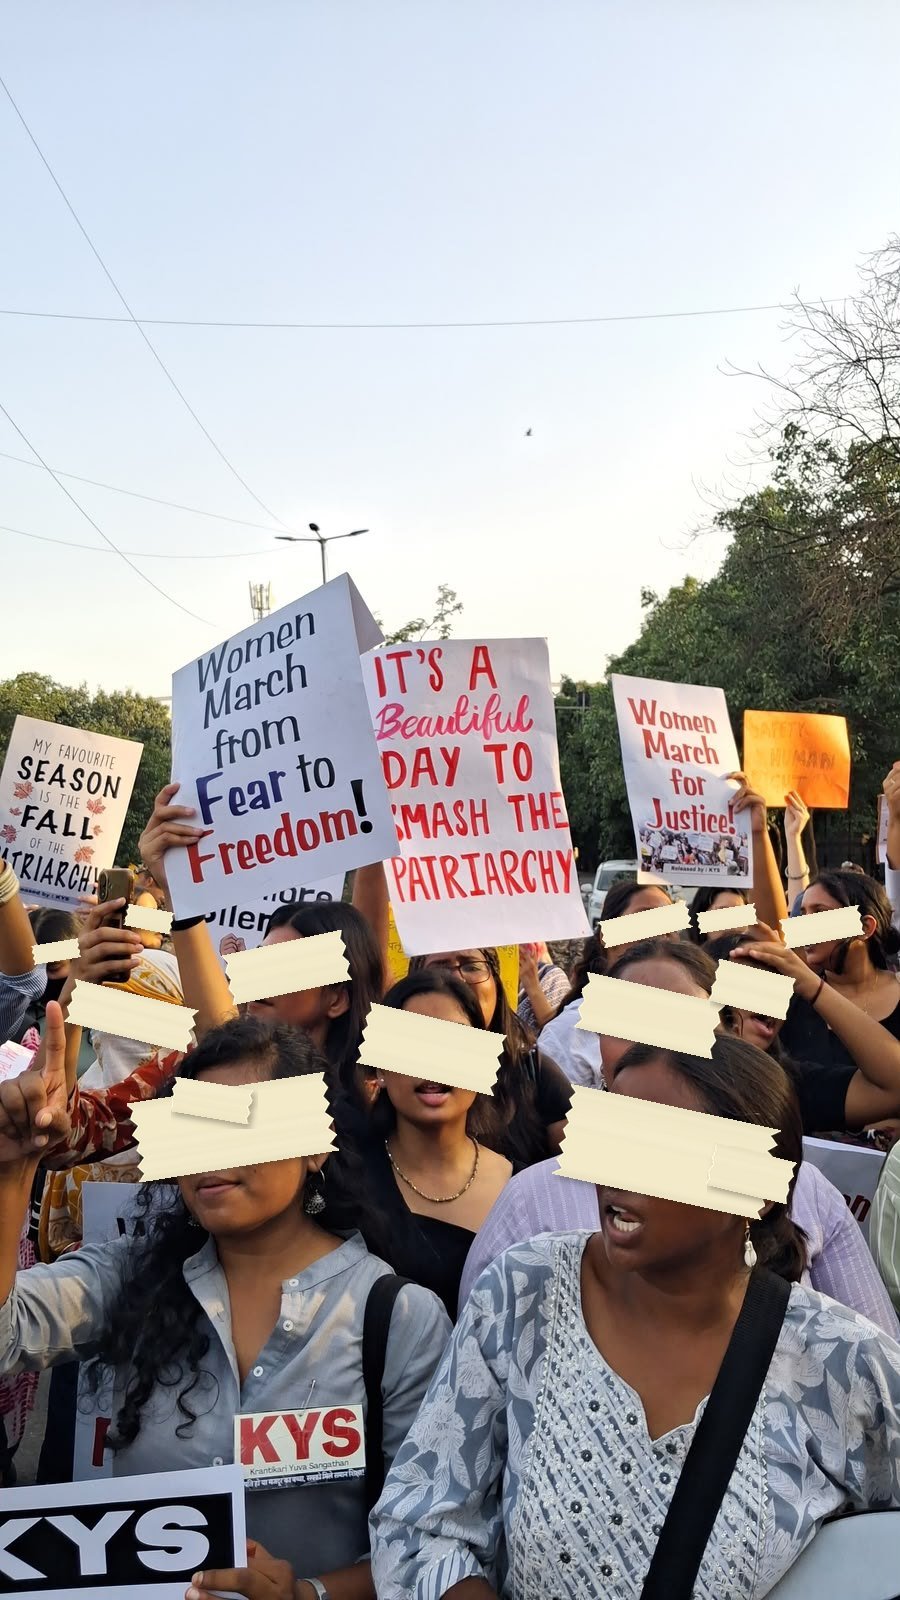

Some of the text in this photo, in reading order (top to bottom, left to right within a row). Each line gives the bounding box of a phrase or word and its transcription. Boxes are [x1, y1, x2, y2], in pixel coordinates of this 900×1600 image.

[197, 612, 316, 693] Women
[374, 645, 498, 698] IT'S A
[203, 652, 308, 730] March
[374, 693, 533, 741] Beautiful
[627, 697, 717, 734] Women
[33, 738, 117, 770] MY FAVOURITE
[212, 715, 301, 770] from
[642, 728, 720, 765] March
[17, 755, 122, 799] SEASON
[380, 741, 533, 789] DAY TO
[670, 767, 706, 796] for
[39, 790, 81, 810] IS THE
[195, 754, 336, 825] Fear to
[20, 804, 94, 840] FALL
[186, 779, 373, 884] Freedom!
[507, 792, 570, 832] THE
[647, 797, 736, 834] Justice!
[30, 837, 65, 855] OF THE
[391, 849, 572, 903] PATRIARCHY
[240, 1408, 361, 1465] KYS
[250, 1460, 349, 1475] Krantikari Yuva Sangathan
